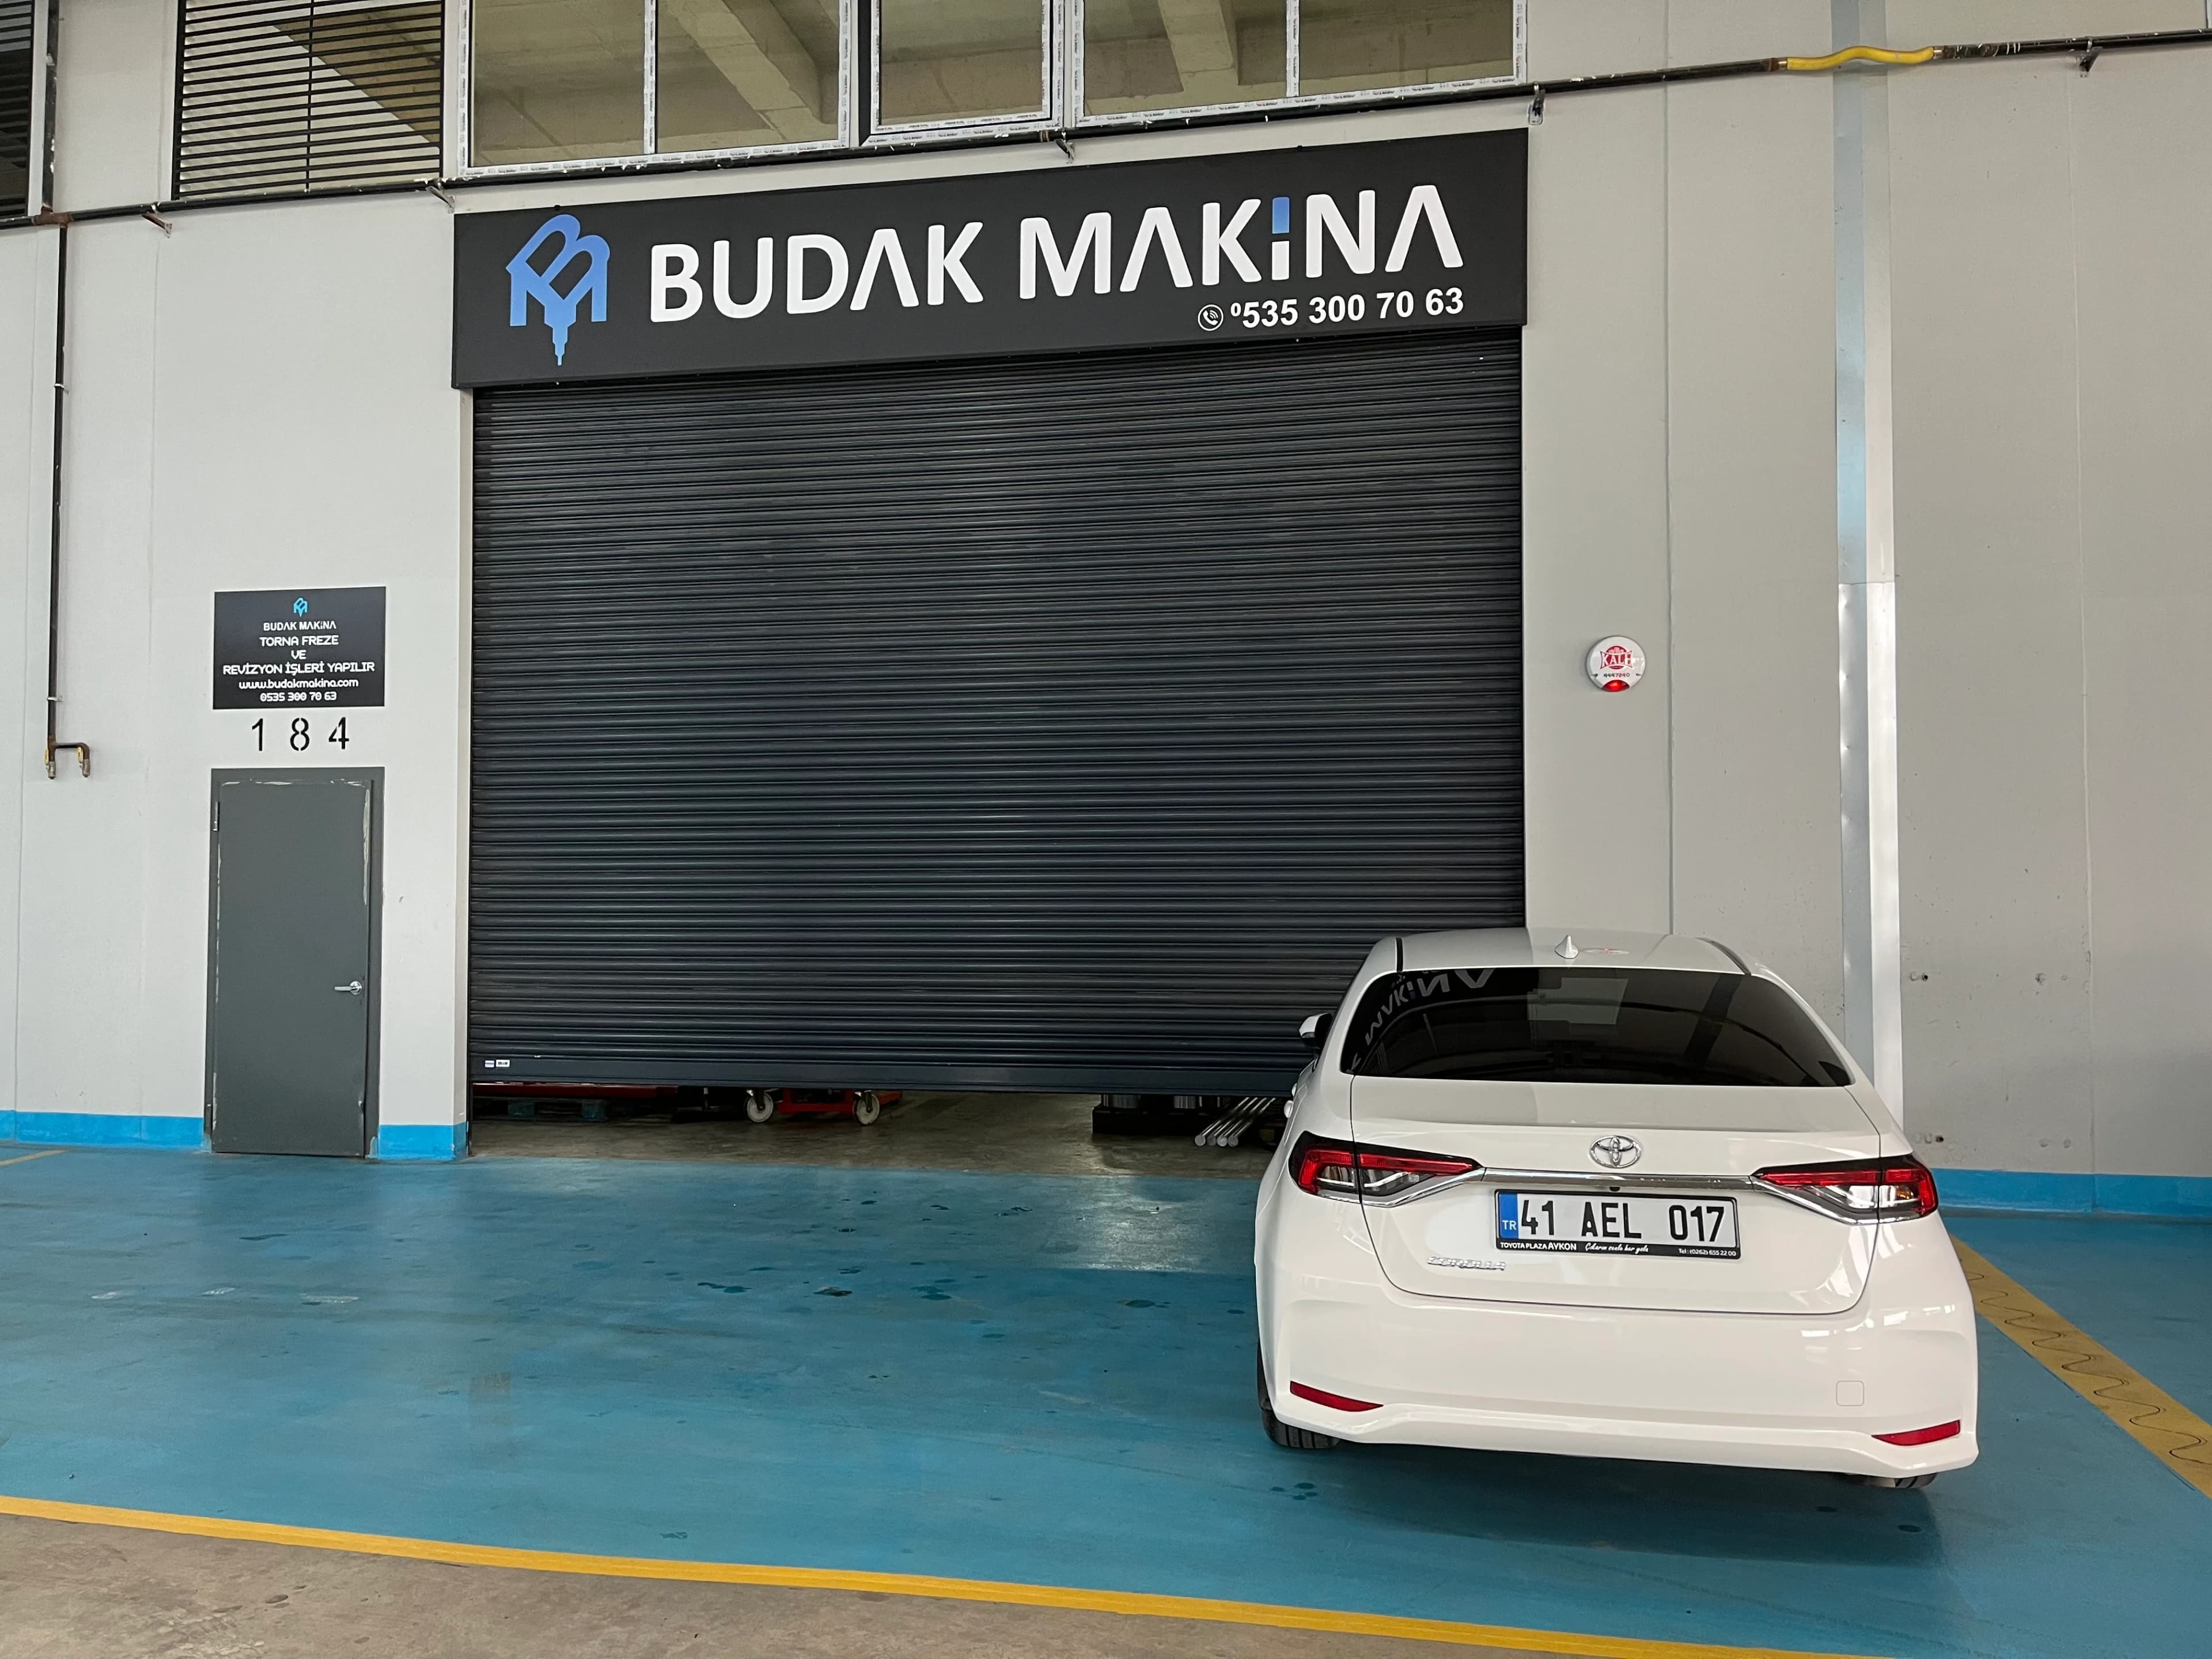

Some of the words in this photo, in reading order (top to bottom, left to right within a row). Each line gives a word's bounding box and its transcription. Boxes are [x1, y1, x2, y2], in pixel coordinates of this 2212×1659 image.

[650, 221, 984, 323] BUDAK
[1309, 294, 1366, 324] 300
[1376, 290, 1414, 319] 70
[1425, 287, 1464, 316] 63
[263, 622, 297, 631] BUDAK
[259, 636, 299, 646] TORNA
[301, 635, 339, 646] FREZE
[291, 649, 307, 660] VE
[1600, 650, 1633, 669] KALE
[223, 662, 283, 675] REVİZYON
[285, 661, 325, 676] İŞLERİ
[327, 661, 375, 673] YAPILIR
[238, 677, 359, 690] www.budakmakina.com
[260, 692, 286, 702] 0535
[287, 692, 307, 702] 300
[309, 691, 322, 701] 70
[324, 691, 337, 700] 63
[1502, 1219, 1517, 1230] TR
[1521, 1200, 1554, 1236] 41
[1581, 1202, 1642, 1239] AEL
[1669, 1205, 1724, 1242] 017
[1548, 1242, 1577, 1251] AYKON
